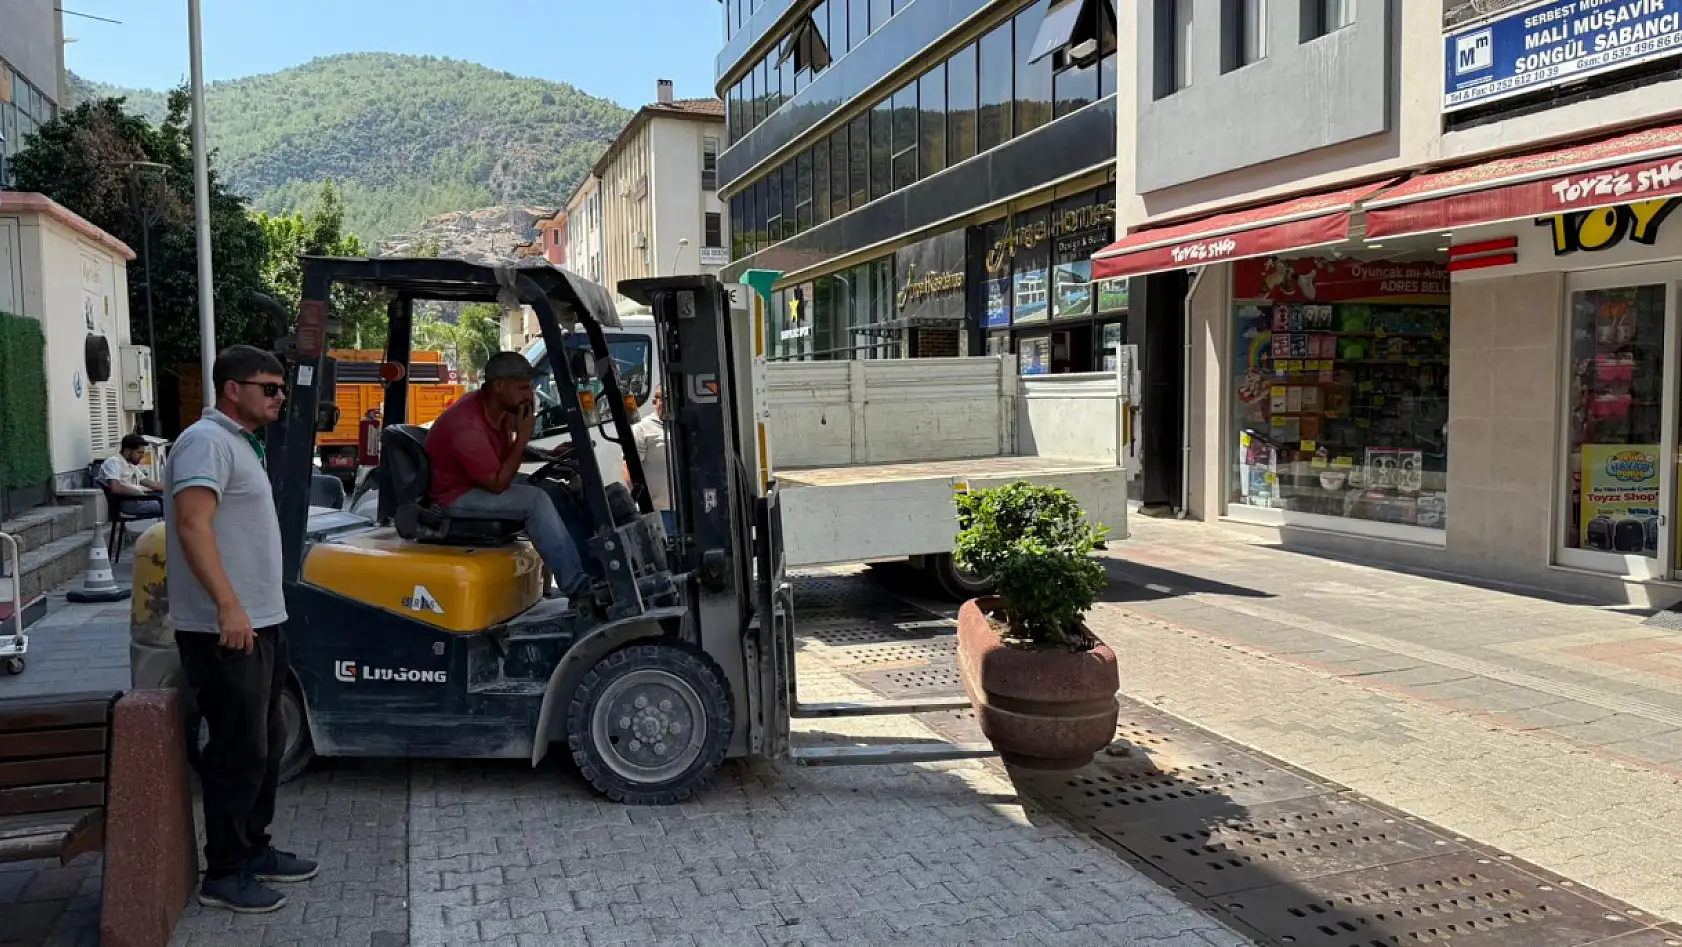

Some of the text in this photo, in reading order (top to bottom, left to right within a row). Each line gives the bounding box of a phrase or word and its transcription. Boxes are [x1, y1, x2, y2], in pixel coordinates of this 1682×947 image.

[1524, 3, 1577, 28] SERBEST
[1515, 12, 1679, 73] SONGÜL SABANCI
[1525, 24, 1568, 50] MALİ
[1602, 51, 1610, 62] 0
[1611, 45, 1632, 60] 532
[1450, 92, 1462, 102] Tel
[1514, 74, 1532, 86] 612
[1534, 70, 1546, 81] 10
[1547, 66, 1560, 77] 39
[1380, 280, 1419, 292] ADRES
[362, 666, 448, 683] LIUGONG
